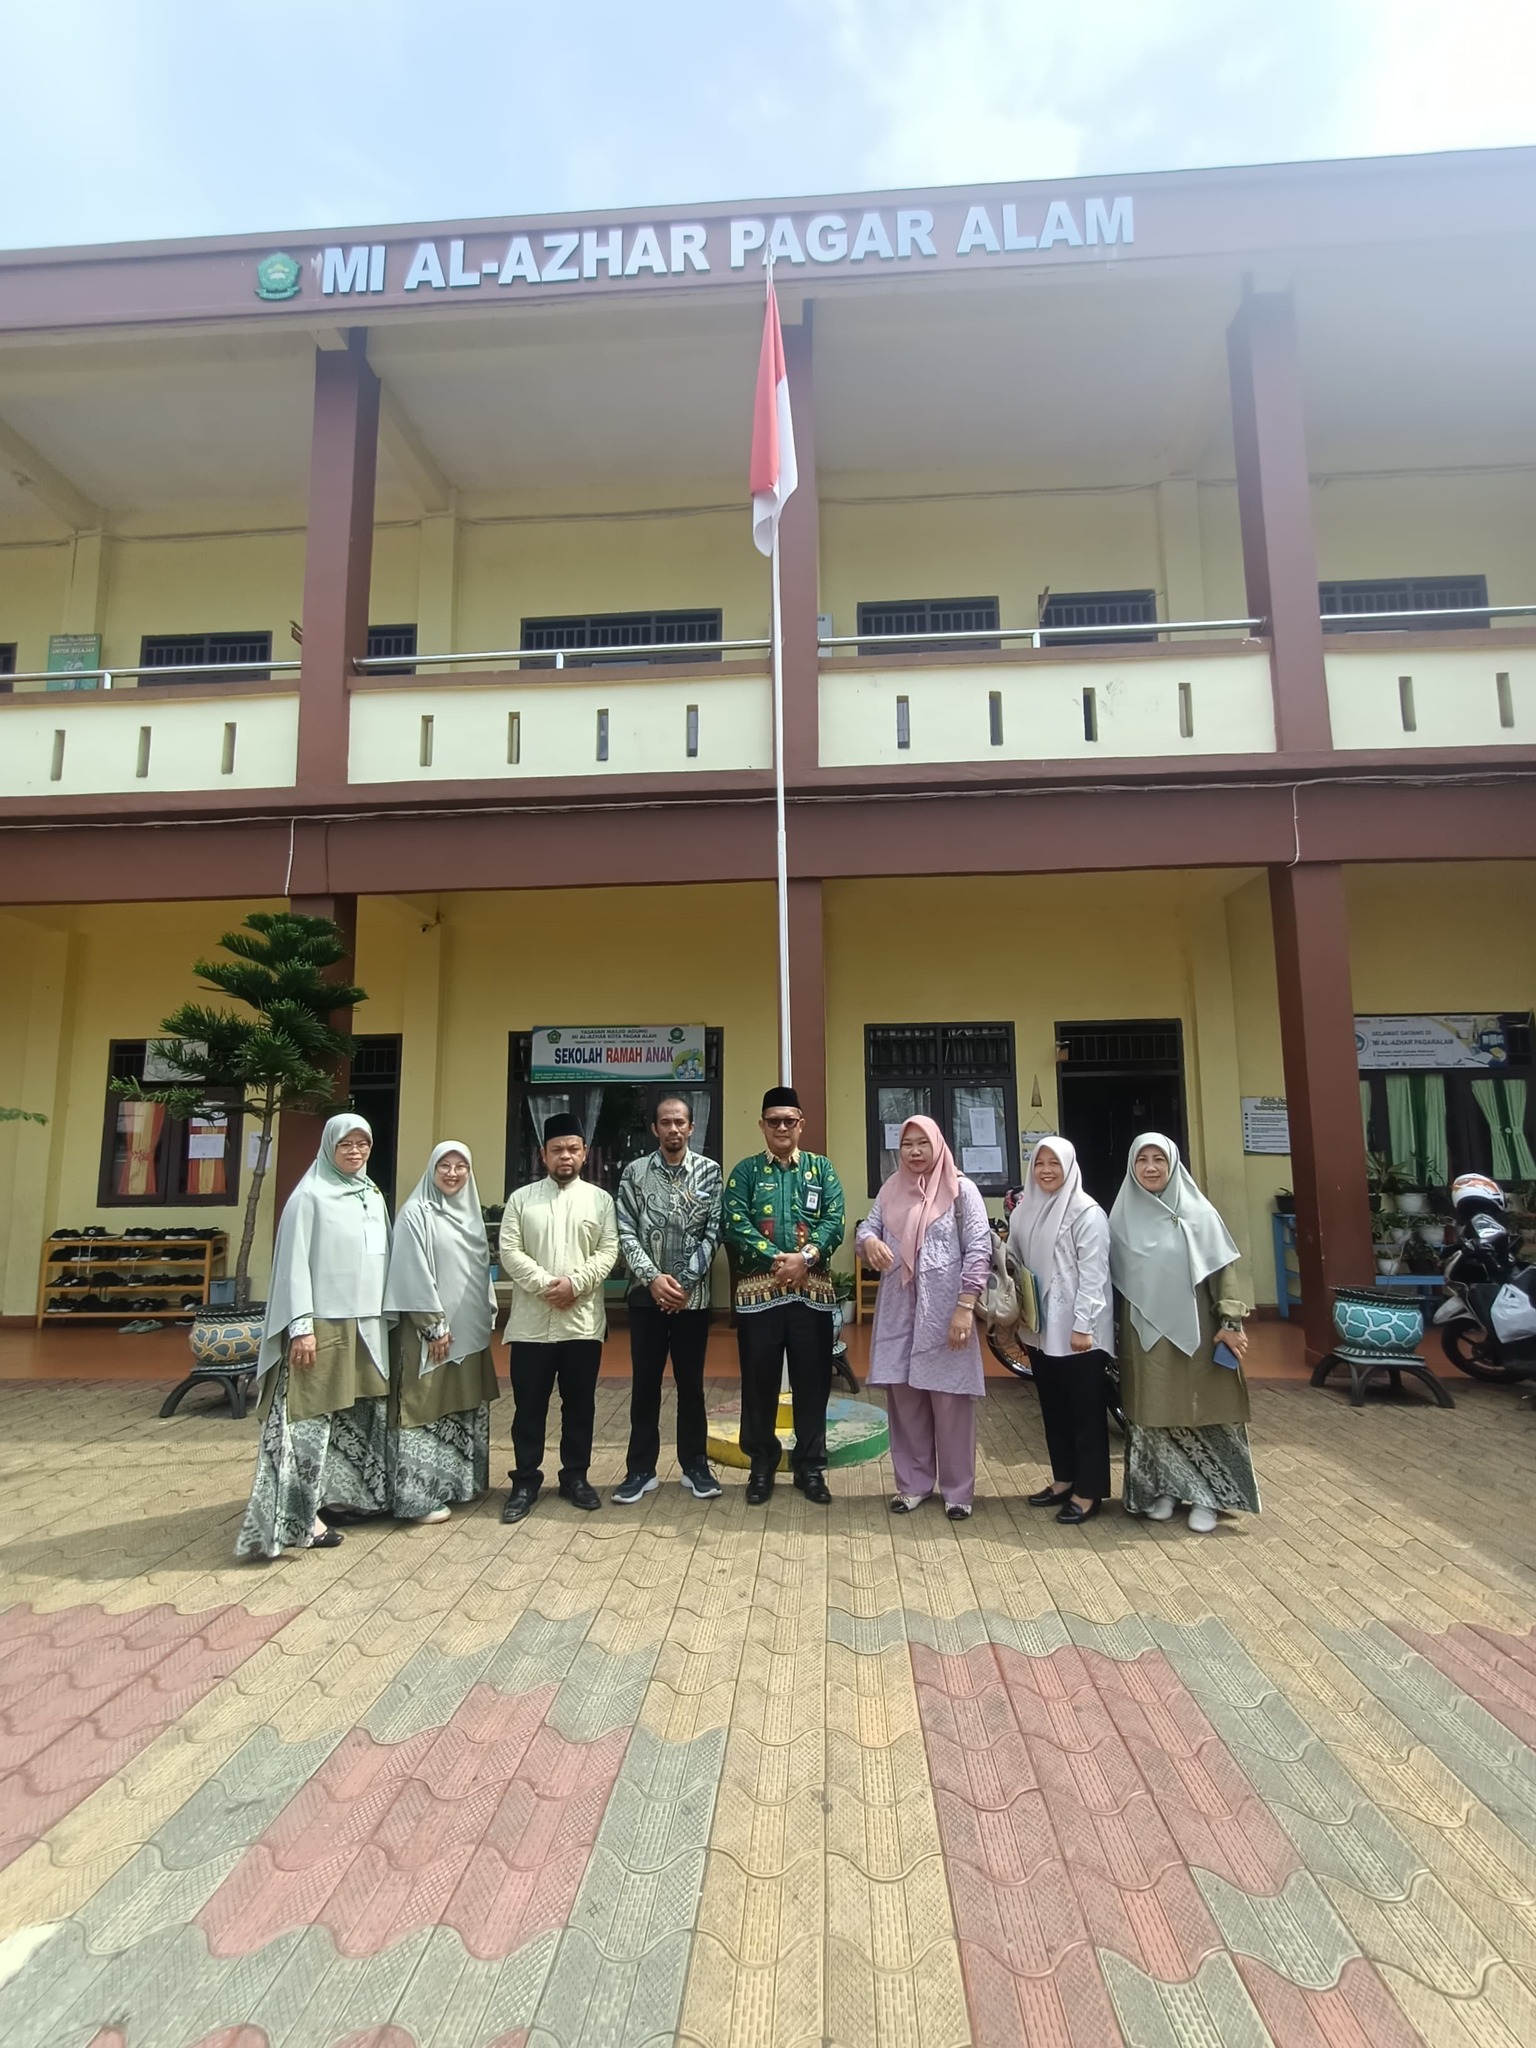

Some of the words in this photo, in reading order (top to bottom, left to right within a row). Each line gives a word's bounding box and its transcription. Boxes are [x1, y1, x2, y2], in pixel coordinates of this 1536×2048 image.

[322, 244, 387, 295] MI
[403, 224, 711, 291] AL-AZHAR
[730, 209, 938, 269] PAGAR
[956, 196, 1135, 254] ALAM
[554, 1047, 602, 1064] SEKOLAH
[606, 1047, 642, 1063] RAMAH
[645, 1046, 674, 1062] ANAK
